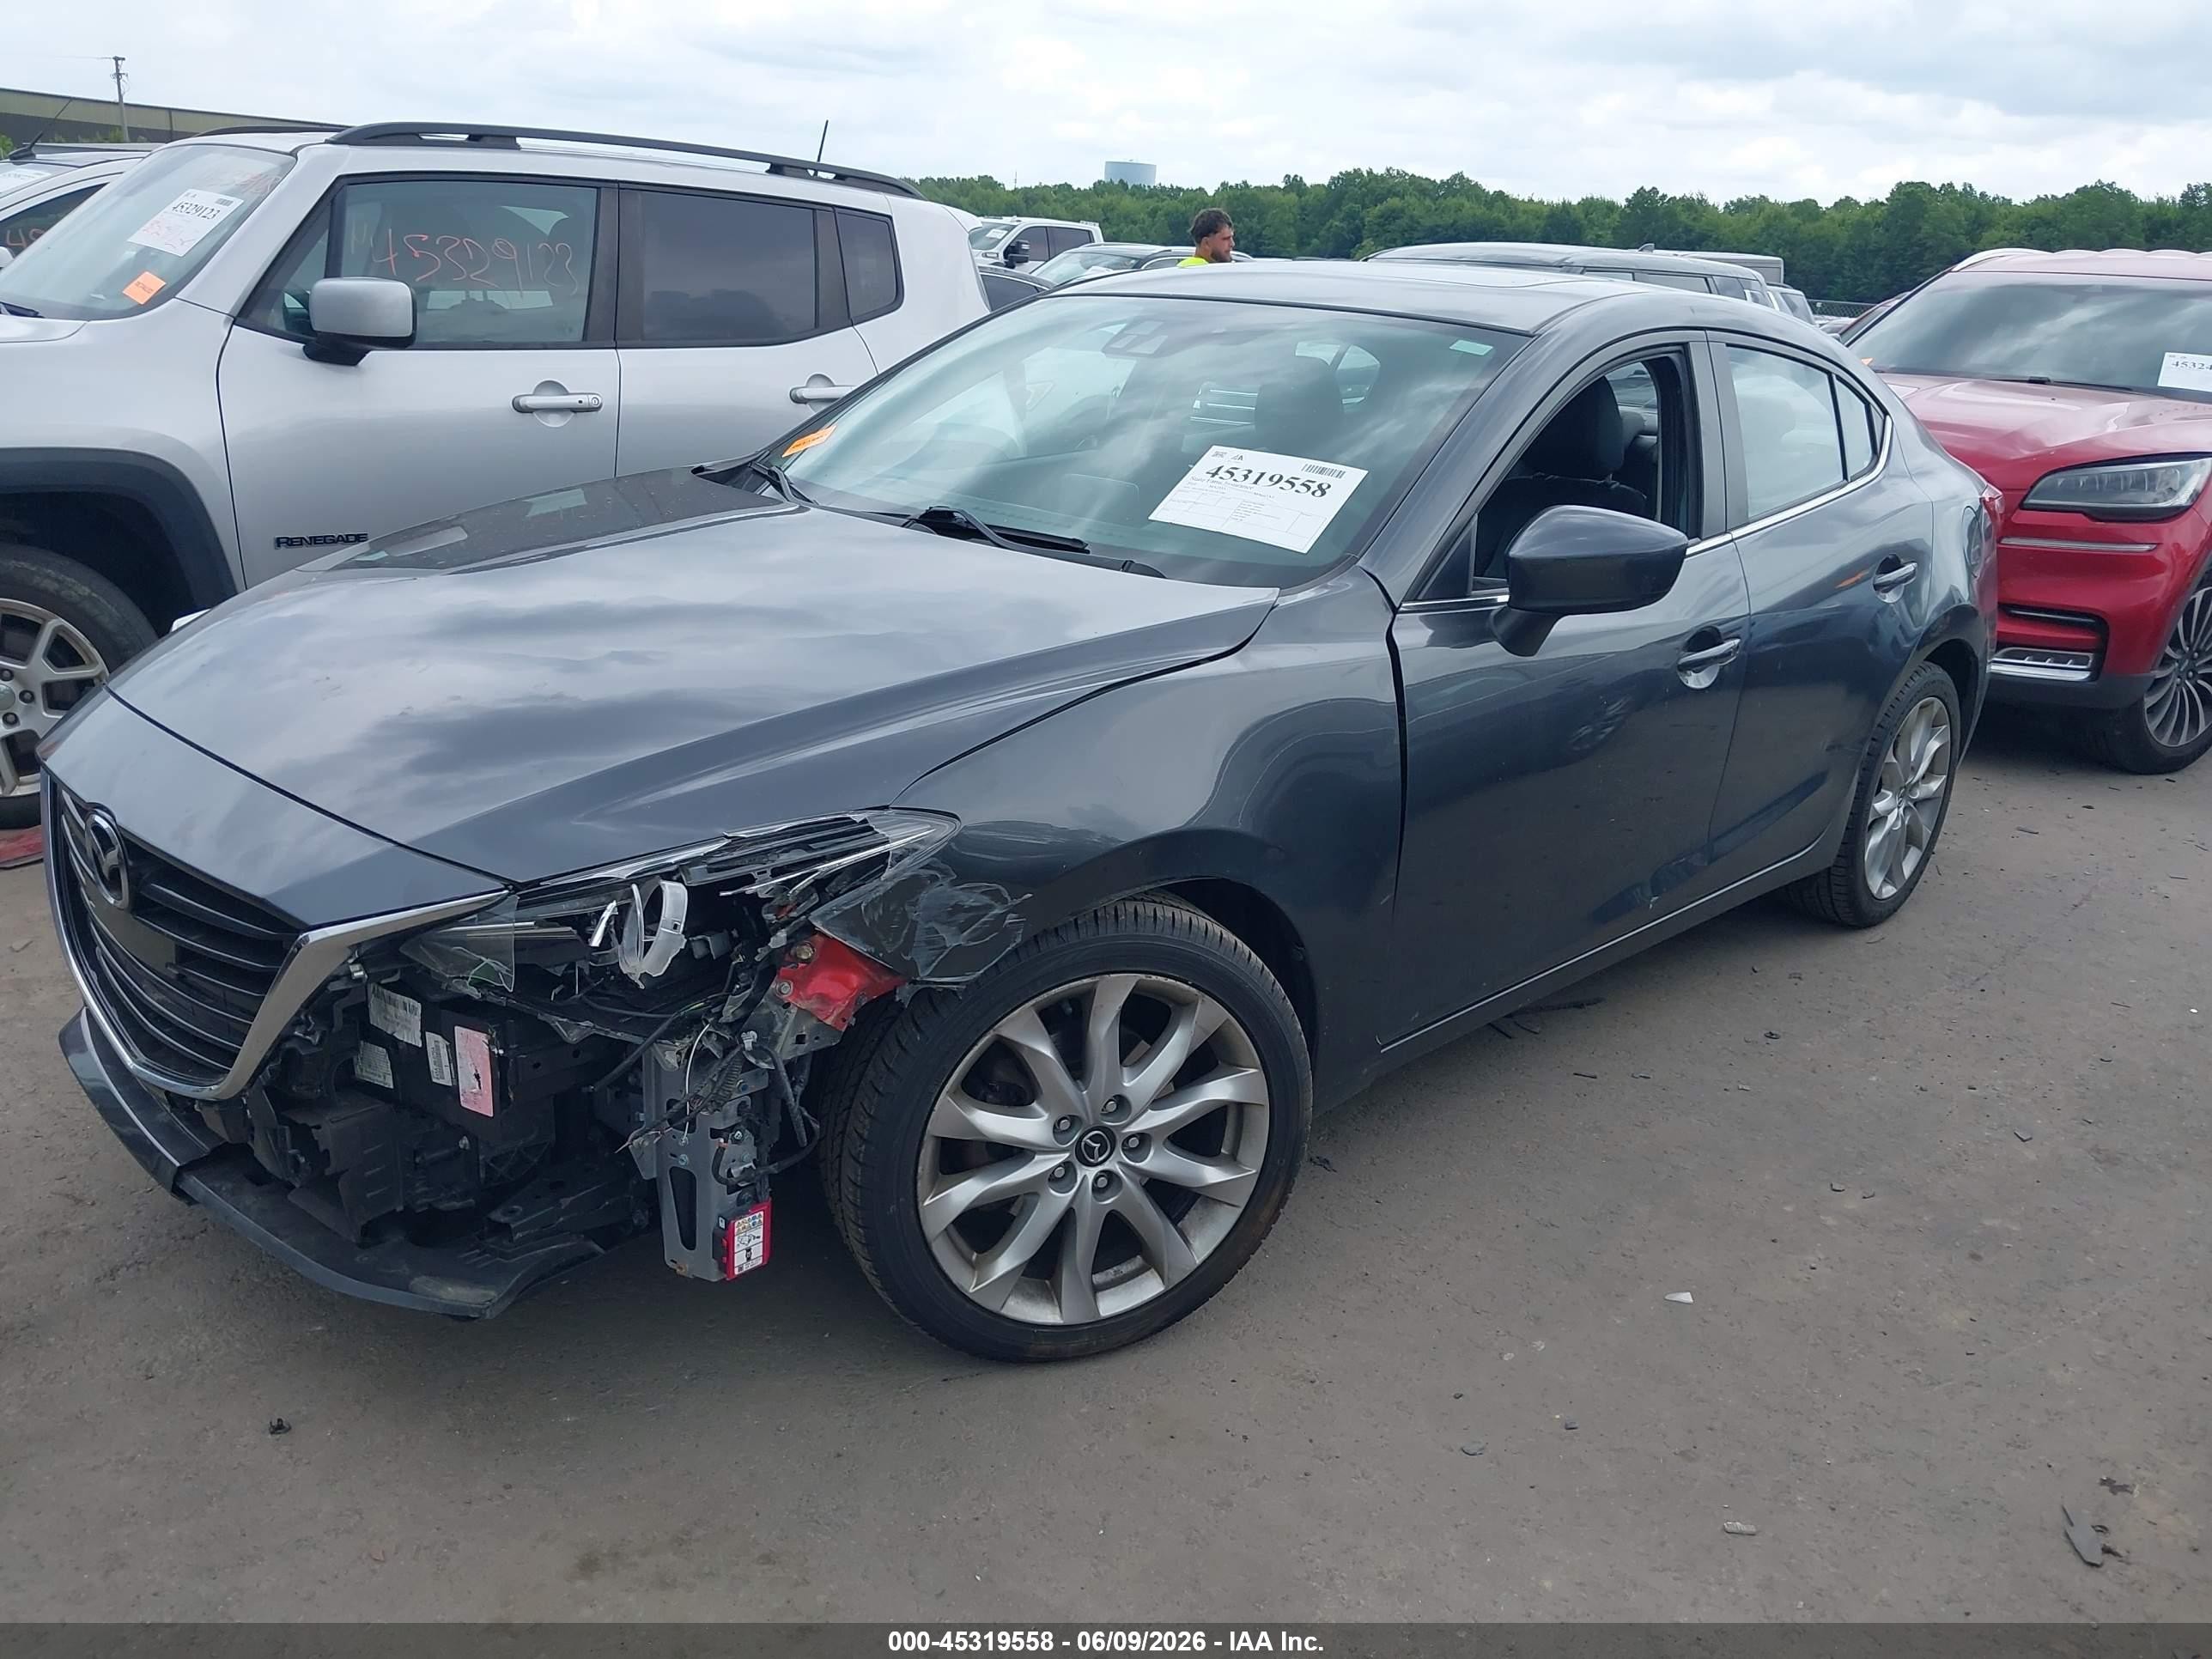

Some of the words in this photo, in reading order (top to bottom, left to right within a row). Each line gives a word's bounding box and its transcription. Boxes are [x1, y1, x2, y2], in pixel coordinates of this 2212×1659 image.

[371, 228, 579, 300] 45329123
[1206, 465, 1332, 498] 45319558
[276, 533, 368, 548] RENEGADE
